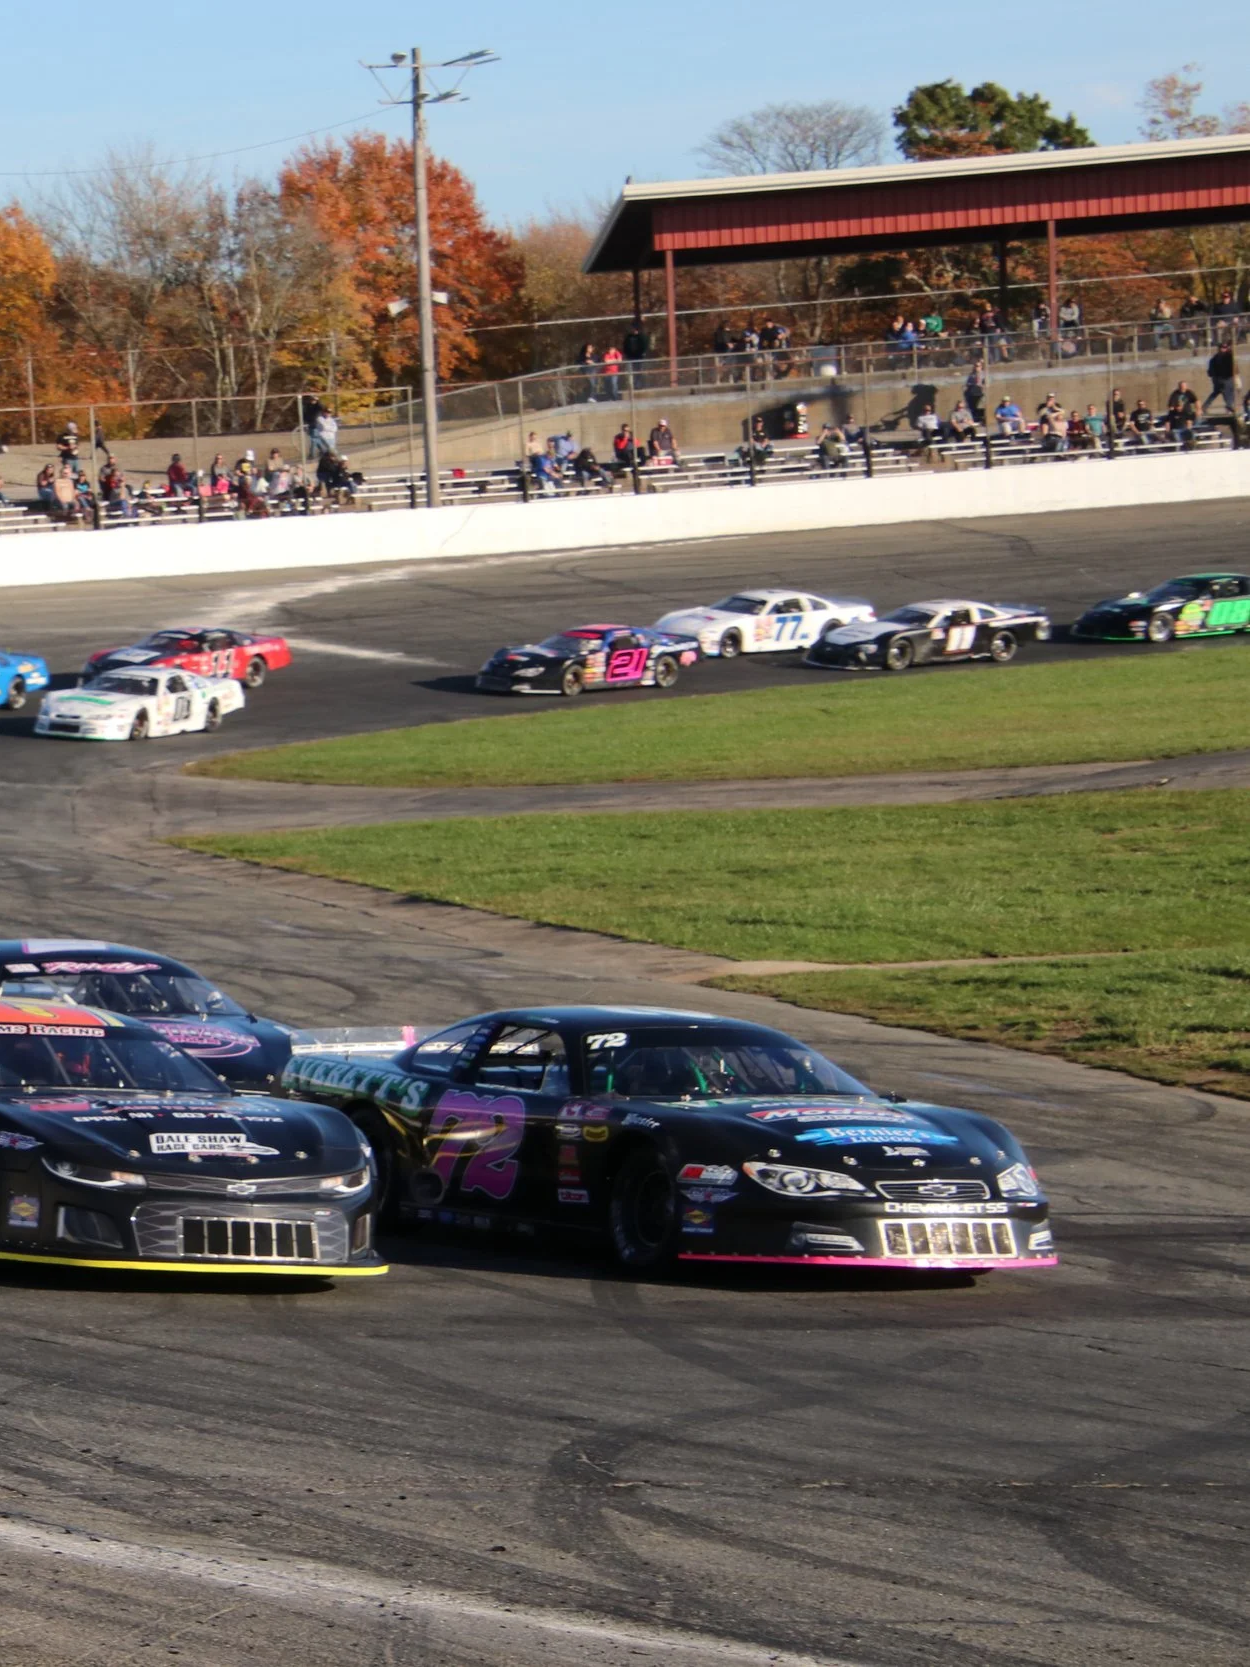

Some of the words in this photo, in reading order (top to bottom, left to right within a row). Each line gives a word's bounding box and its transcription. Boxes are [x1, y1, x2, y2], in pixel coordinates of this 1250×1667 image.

[774, 615, 804, 642] 77
[606, 648, 649, 683] 21
[29, 1024, 106, 1038] RACING
[586, 1032, 628, 1050] 72
[282, 1056, 431, 1110] EVERETT'S
[156, 1134, 194, 1145] DALE
[197, 1134, 243, 1145] SHAW
[825, 1126, 932, 1140] Bernier's
[851, 1135, 923, 1144] LIQUORS
[157, 1143, 190, 1151] RACE
[192, 1143, 225, 1151] CARS
[431, 1089, 527, 1200] 72
[884, 1201, 984, 1213] CHEVROLET
